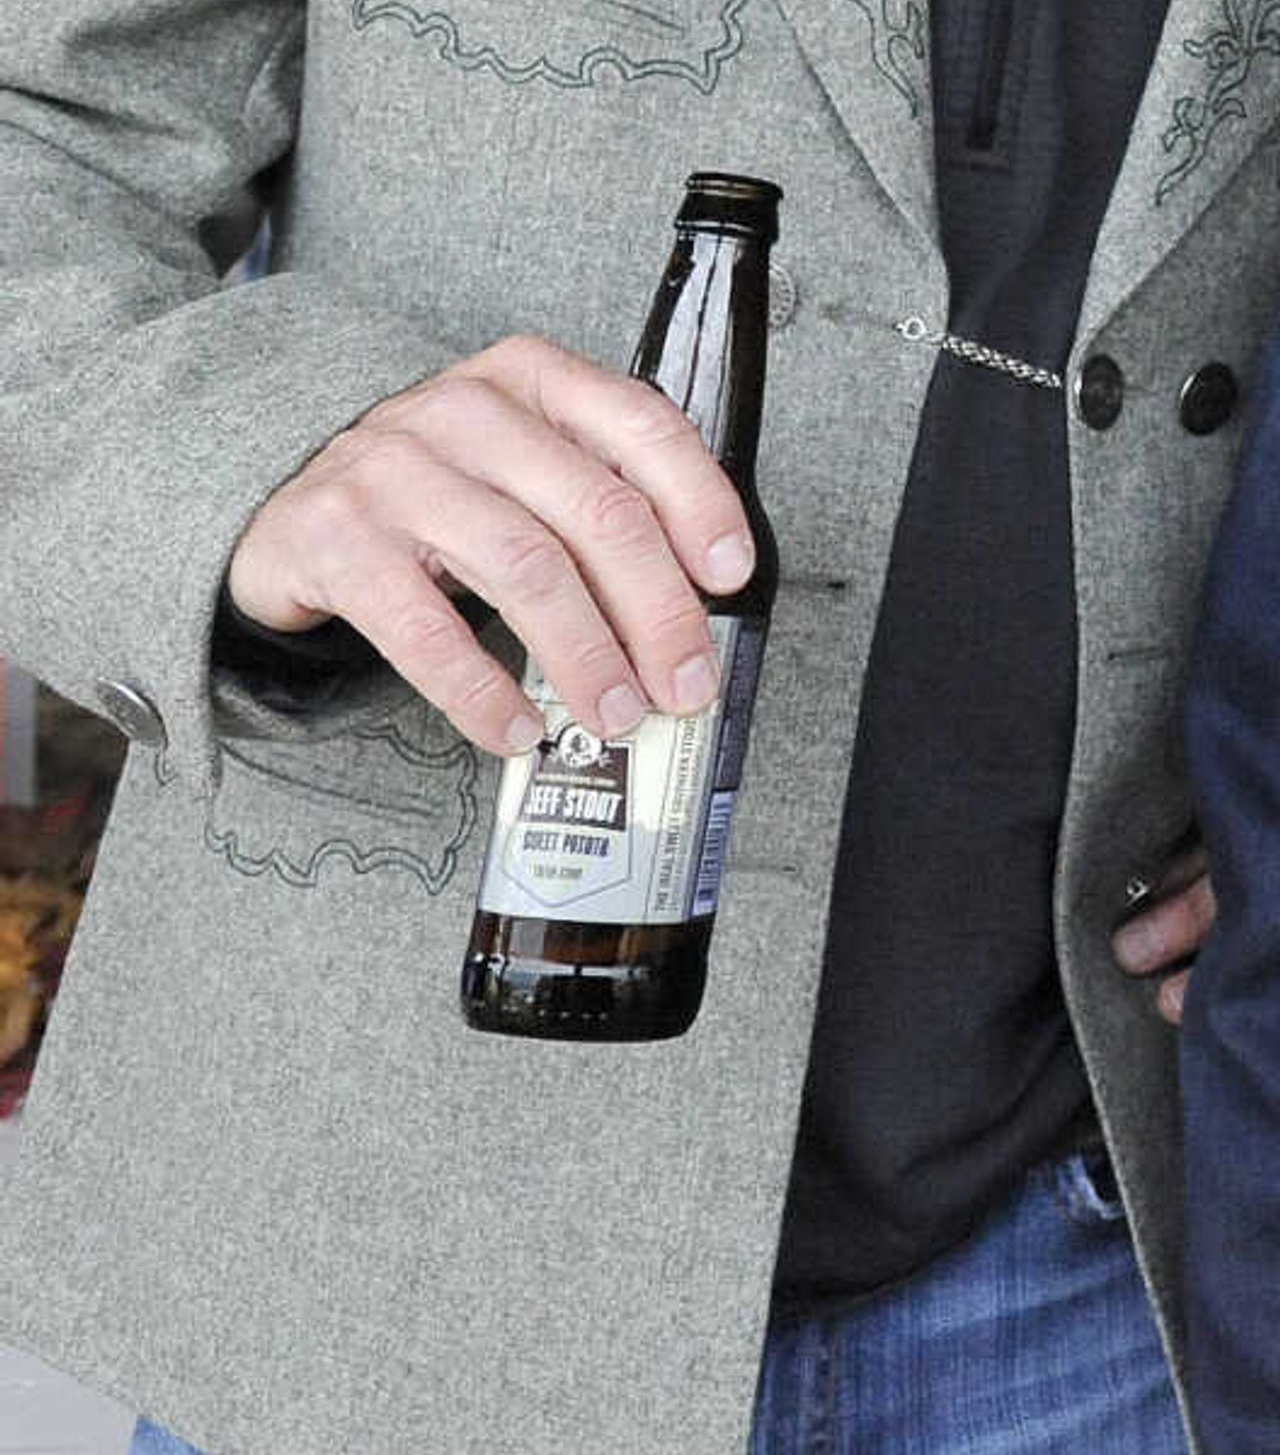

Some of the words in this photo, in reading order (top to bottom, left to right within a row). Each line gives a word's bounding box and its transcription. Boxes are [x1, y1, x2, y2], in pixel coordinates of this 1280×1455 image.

[524, 785, 564, 817] JEFF
[563, 787, 624, 824] STOUT
[563, 834, 610, 858] POTATO
